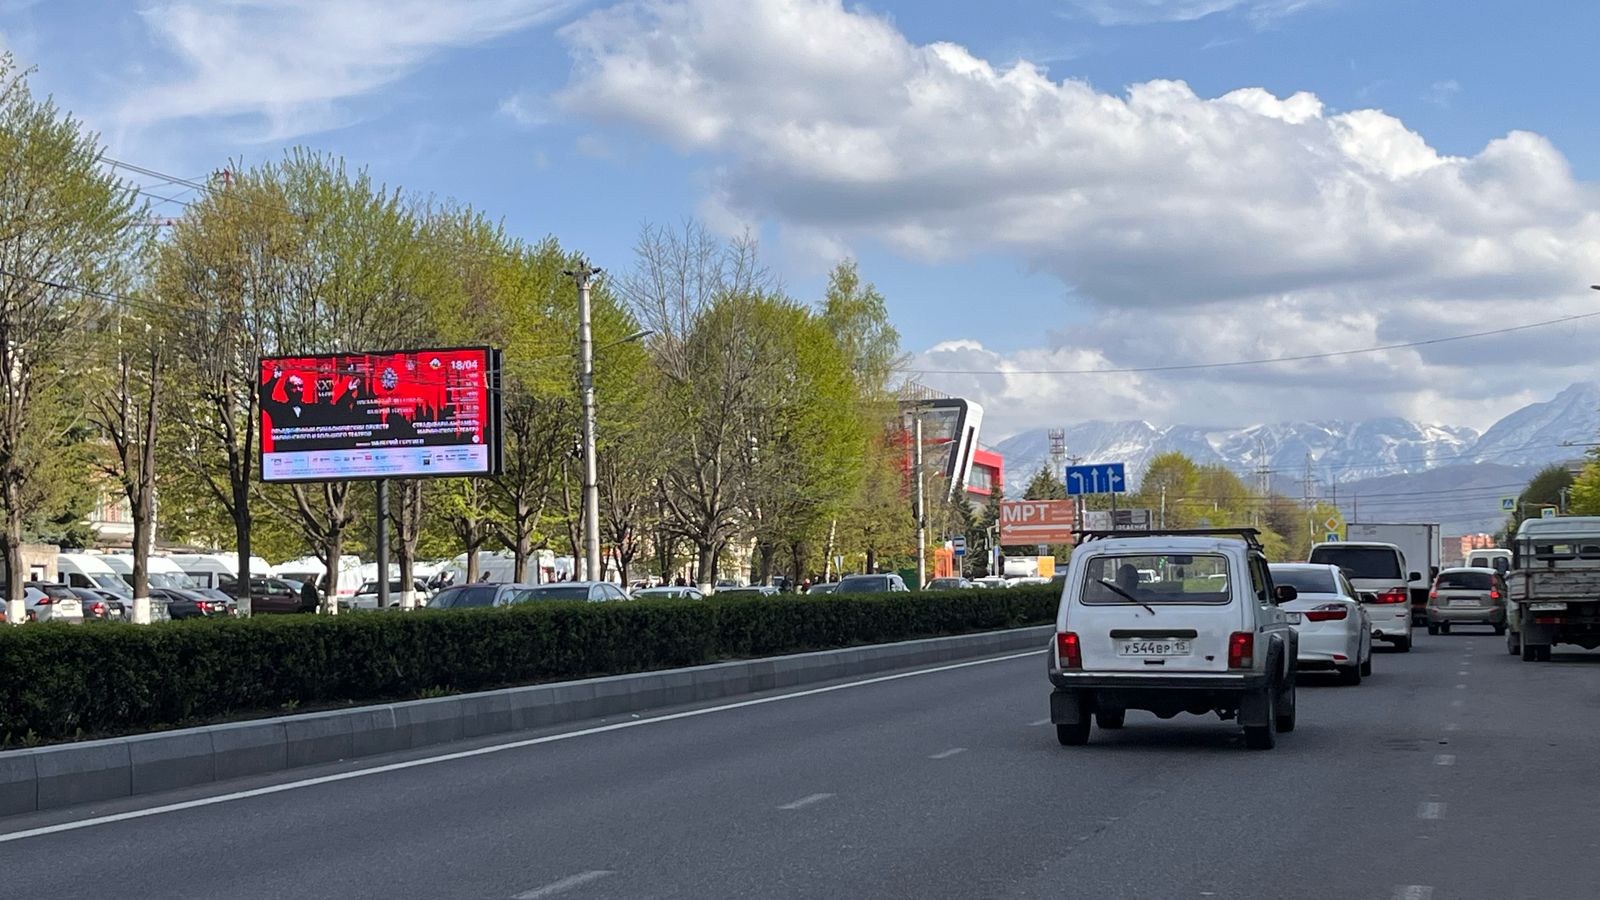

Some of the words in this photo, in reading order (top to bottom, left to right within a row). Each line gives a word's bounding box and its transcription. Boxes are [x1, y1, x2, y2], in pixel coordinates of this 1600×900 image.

[451, 360, 478, 370] 18/04
[1002, 504, 1050, 522] МРТ
[1125, 642, 1170, 654] У544ВР
